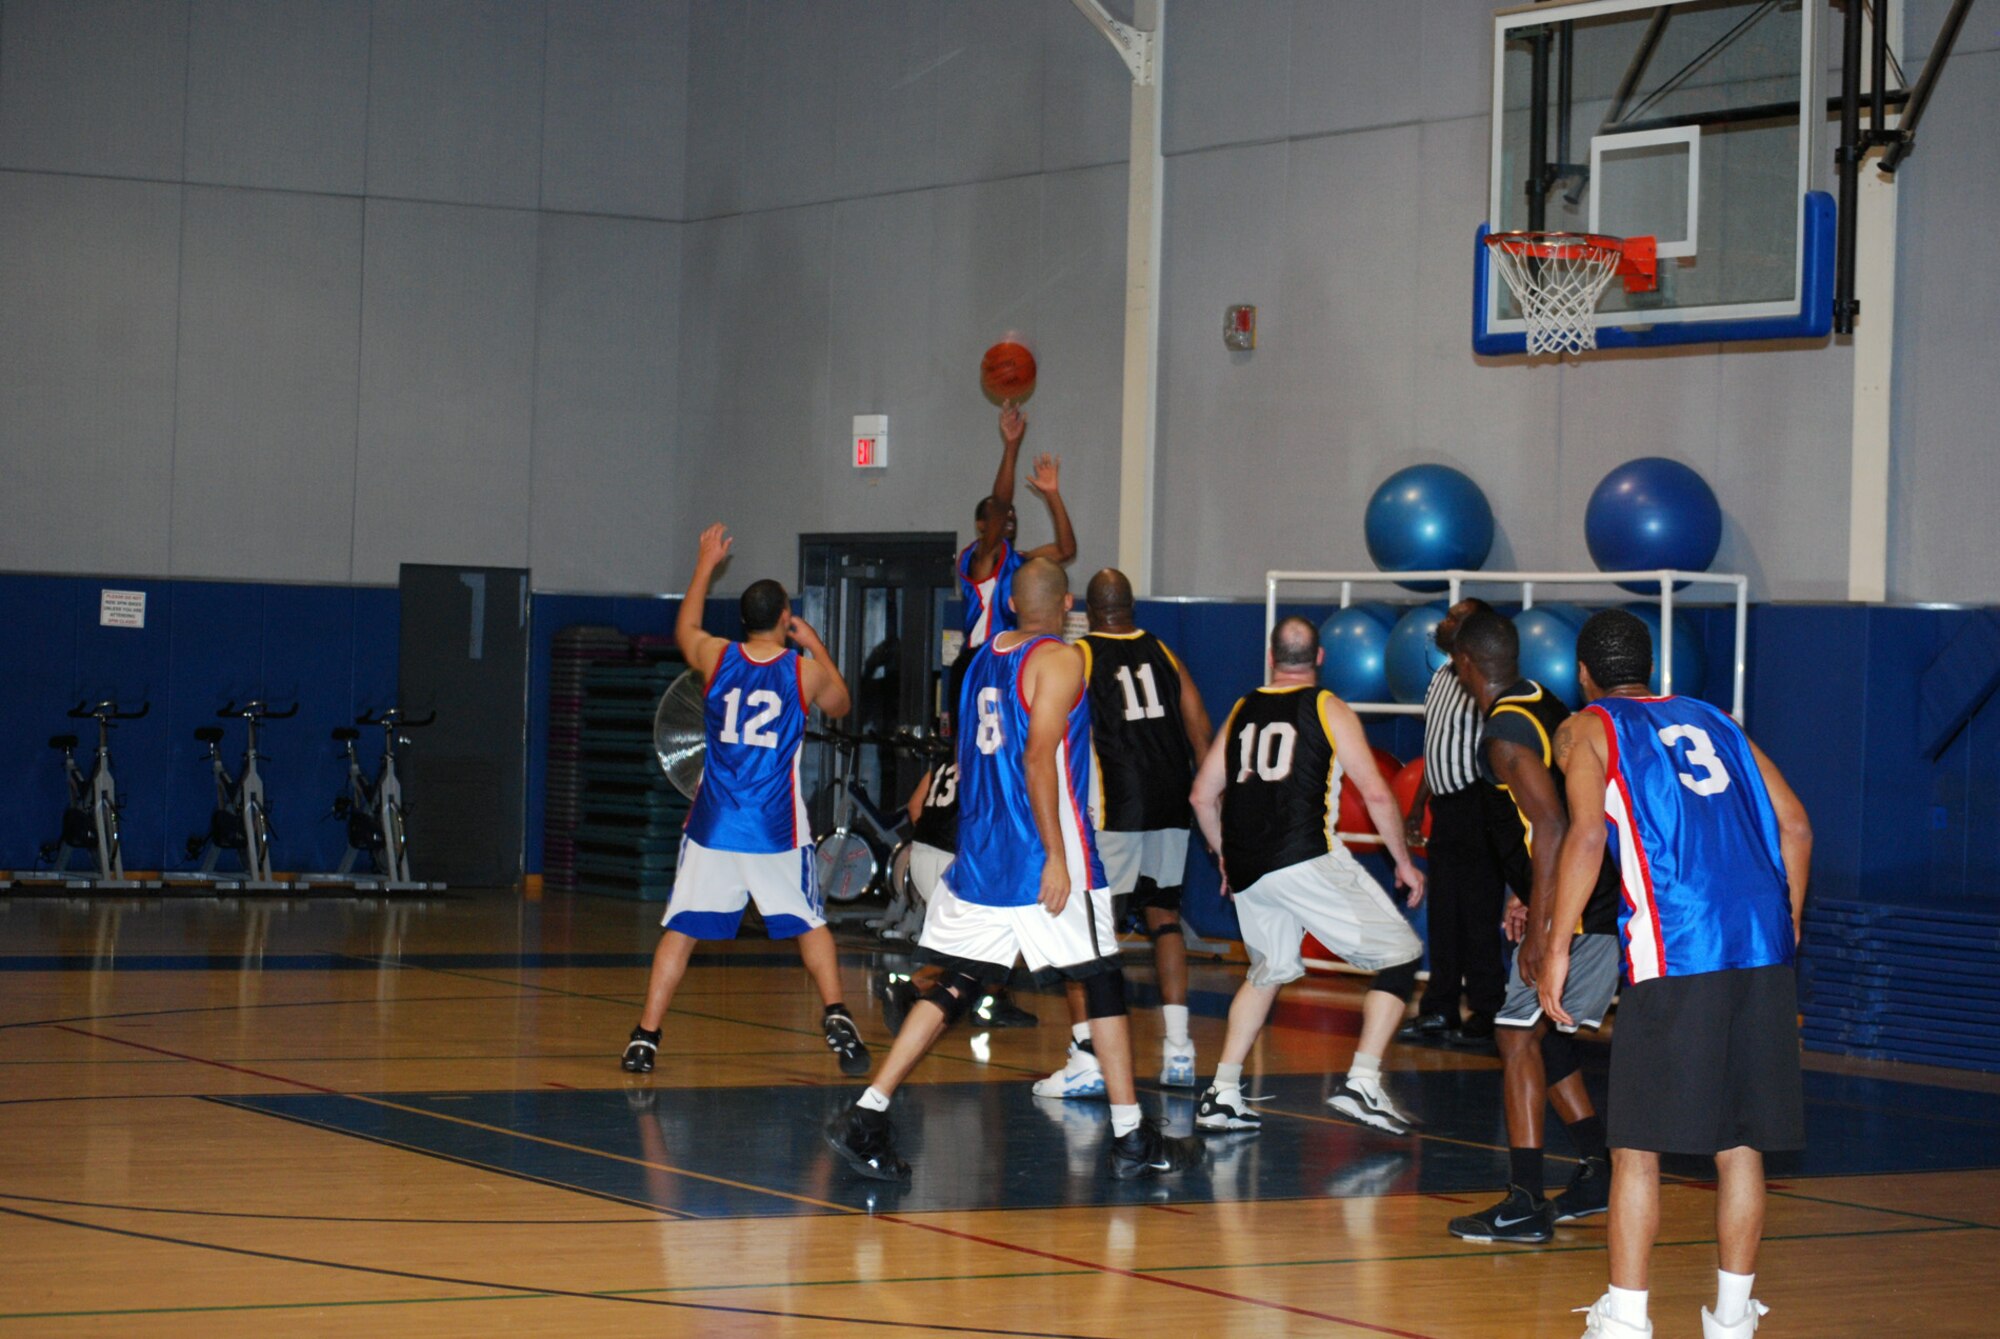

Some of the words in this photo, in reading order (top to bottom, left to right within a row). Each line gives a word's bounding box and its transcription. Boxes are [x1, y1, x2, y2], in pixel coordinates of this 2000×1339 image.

[857, 438, 876, 465] EXIT
[720, 687, 782, 749] 12
[976, 686, 1003, 755] 8
[1115, 663, 1165, 721] 11
[1236, 721, 1298, 783] 10
[1658, 723, 1731, 796] 3
[924, 763, 960, 807] 13
